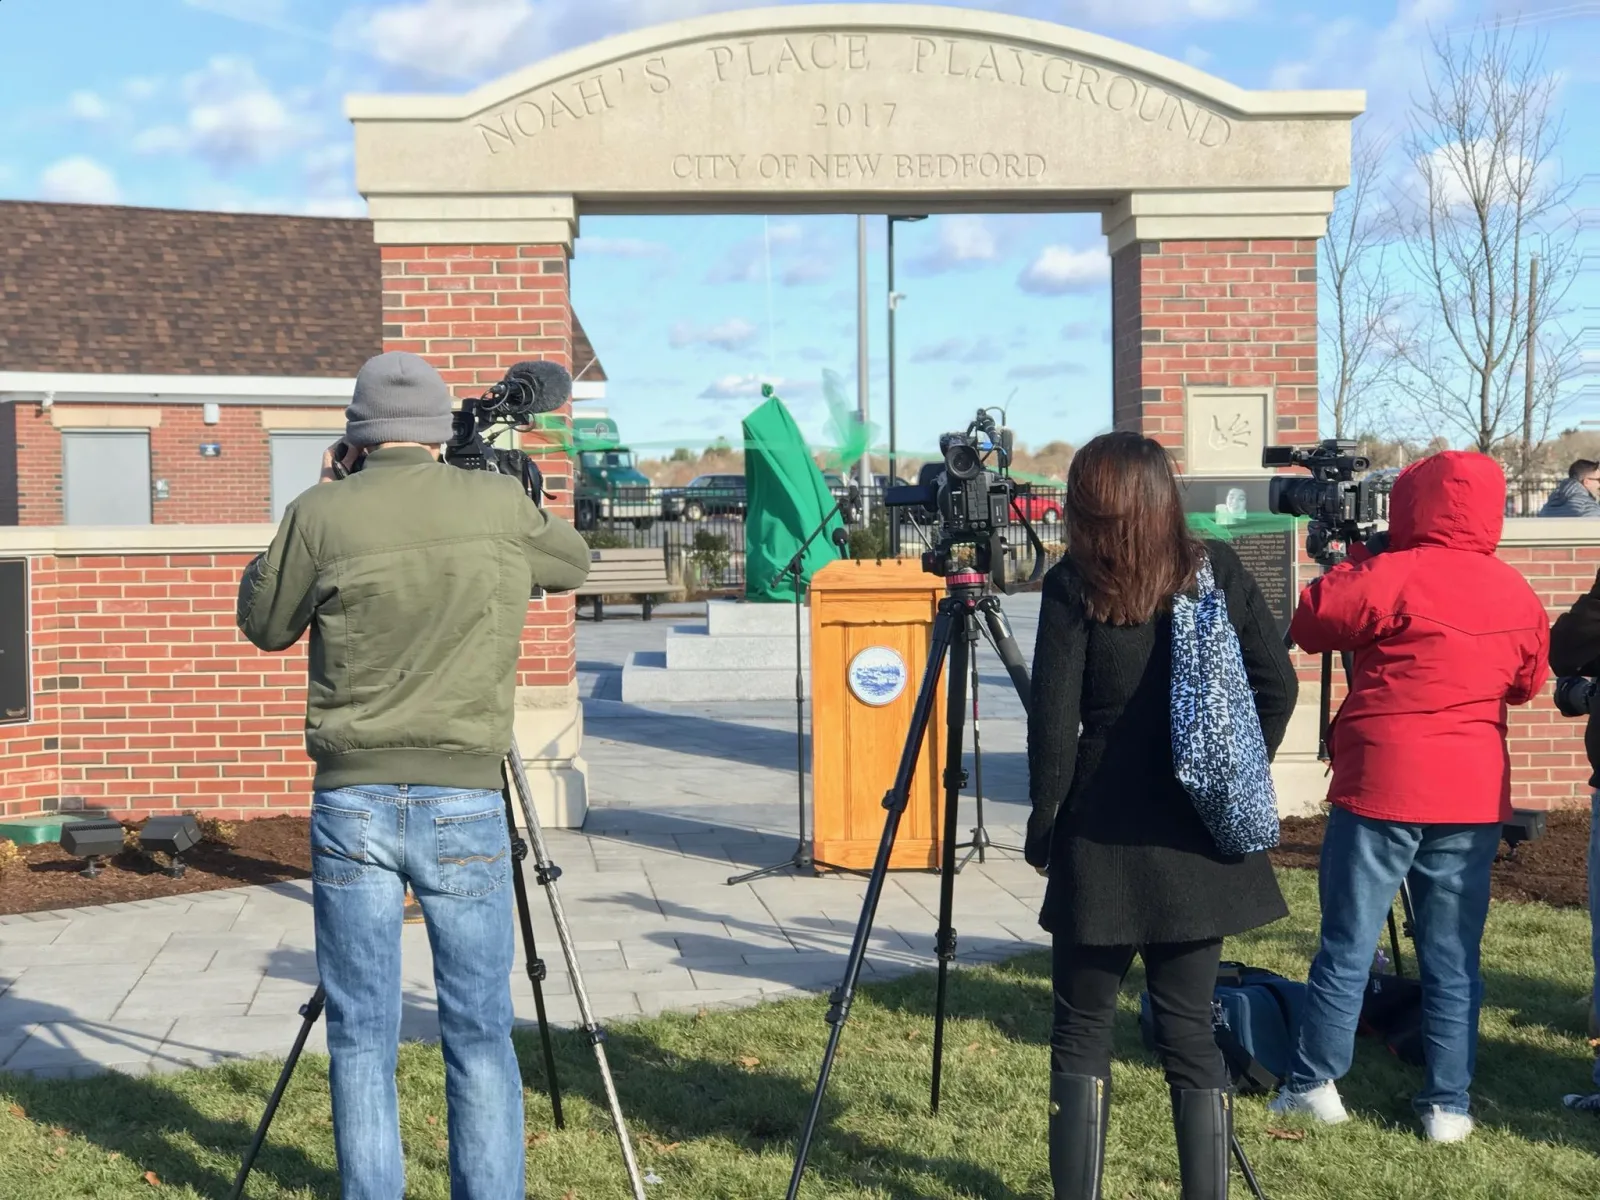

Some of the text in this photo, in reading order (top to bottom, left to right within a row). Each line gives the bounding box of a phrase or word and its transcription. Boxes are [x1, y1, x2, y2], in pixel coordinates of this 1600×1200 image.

[473, 33, 1231, 155] NOAH'S PLACE PLAYGROUND
[815, 102, 897, 128] 2017
[671, 152, 1047, 179] CITY OF NEW BEDFORD
